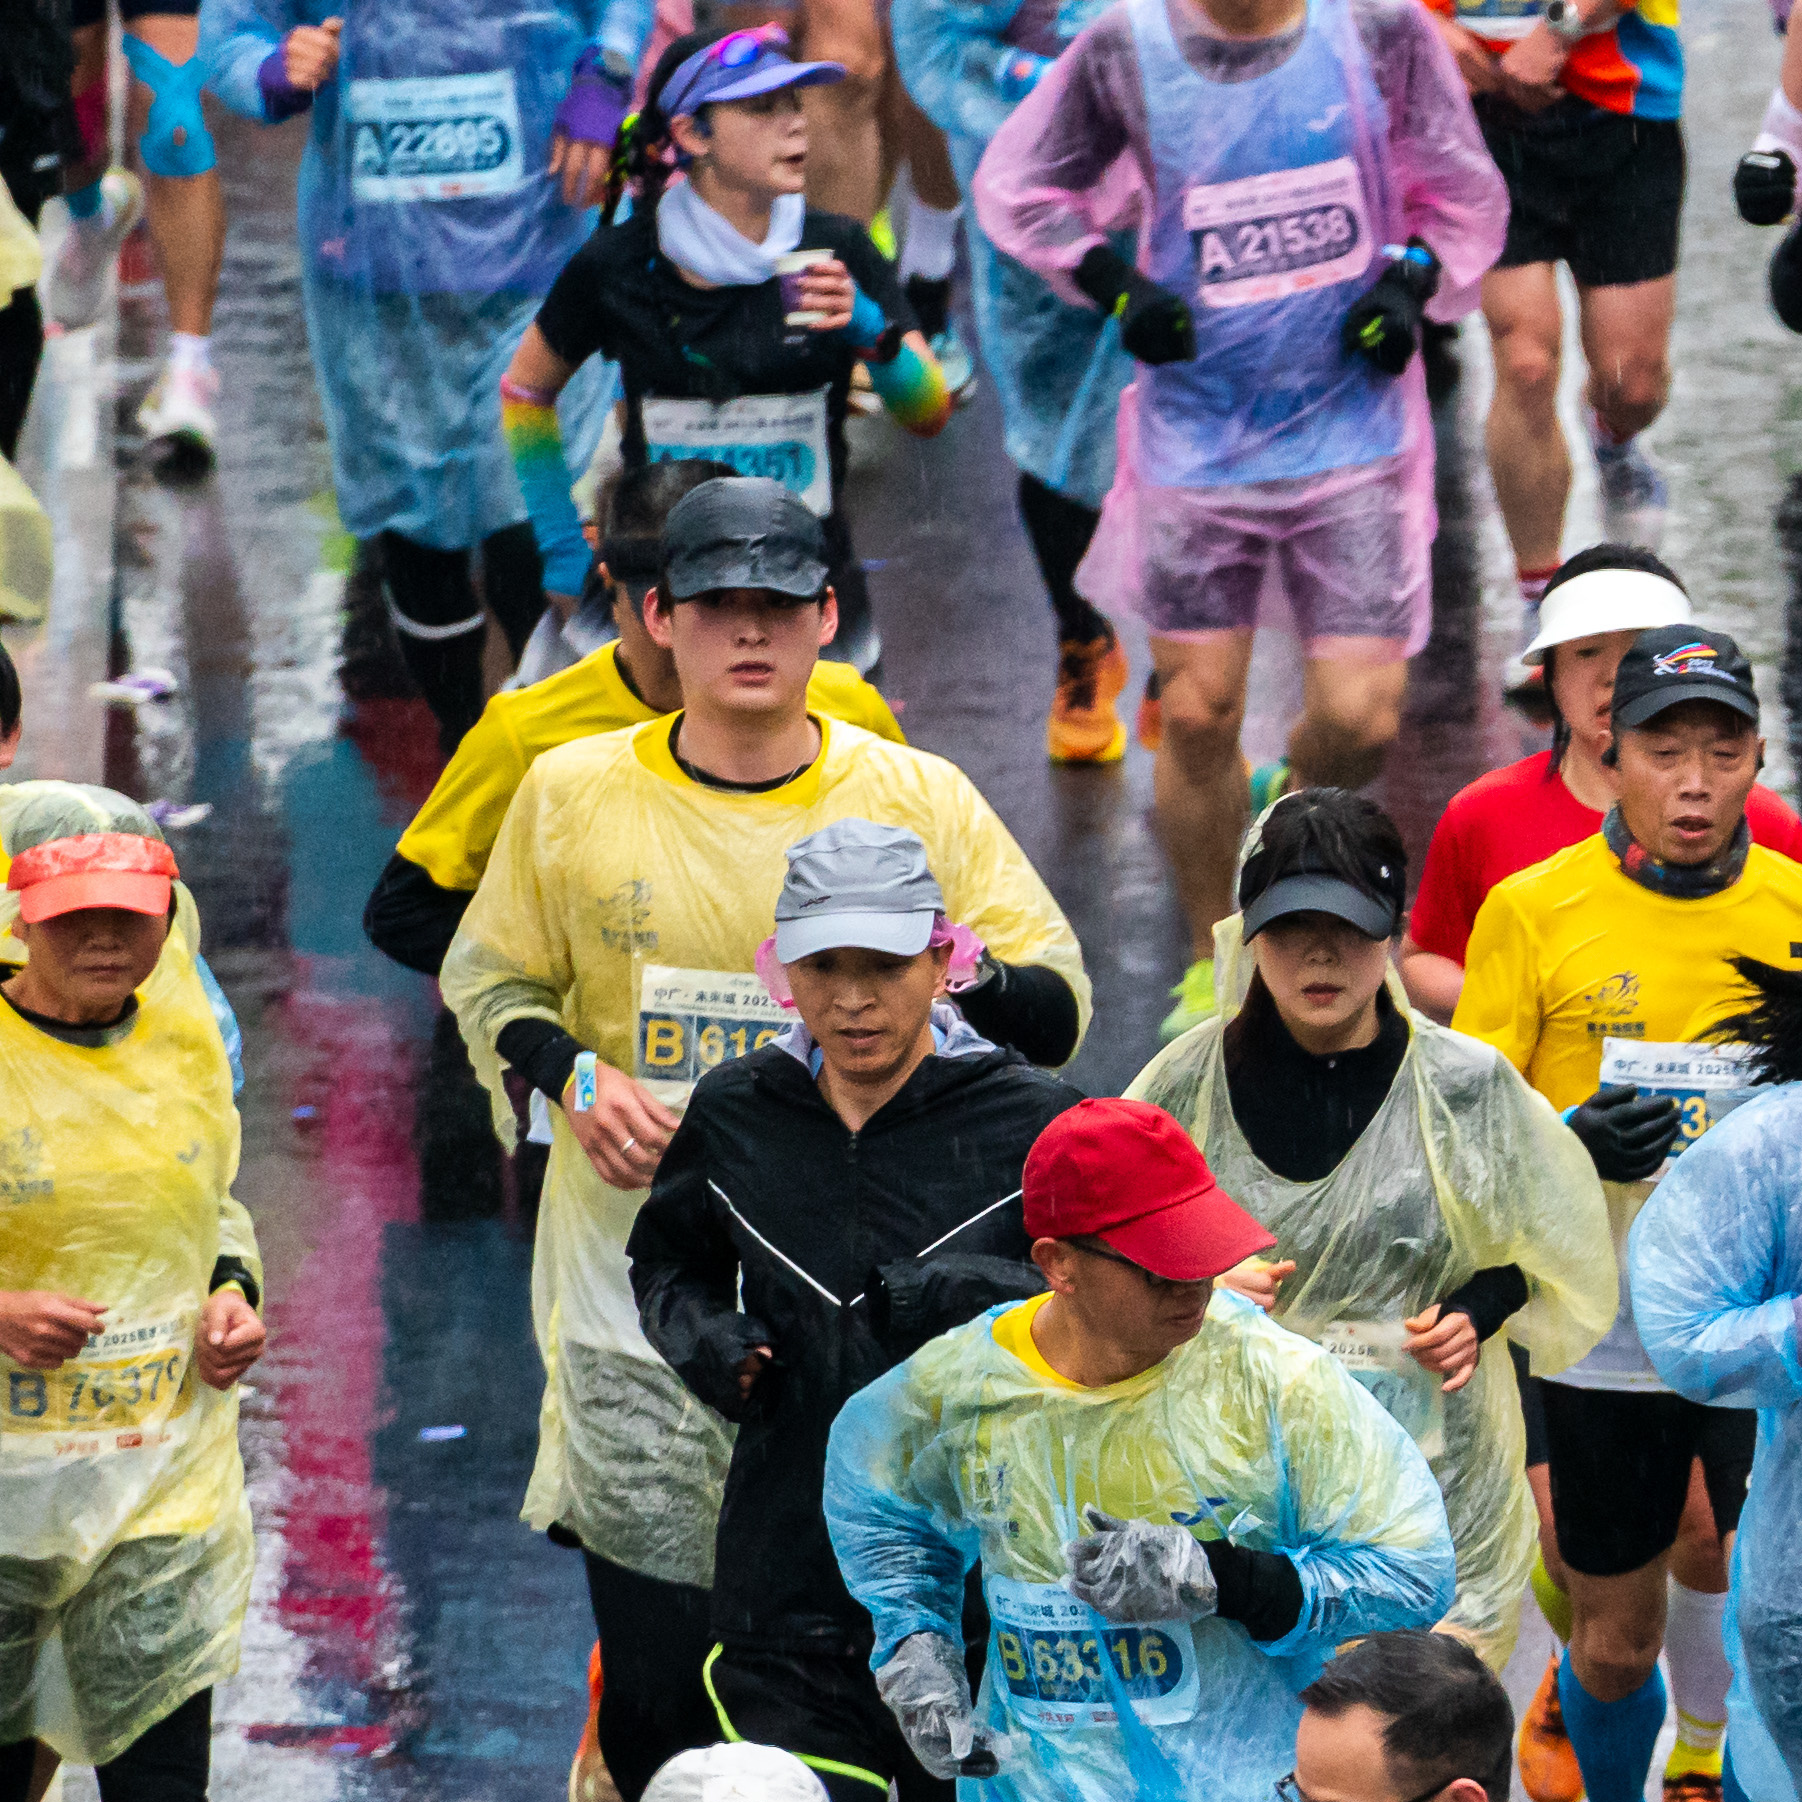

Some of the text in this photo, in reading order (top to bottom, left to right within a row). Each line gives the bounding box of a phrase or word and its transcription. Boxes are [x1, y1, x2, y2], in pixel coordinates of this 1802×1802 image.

[1202, 232, 1236, 274] A
[644, 1019, 685, 1067] B
[9, 1371, 48, 1418] B
[998, 1631, 1026, 1681] B
